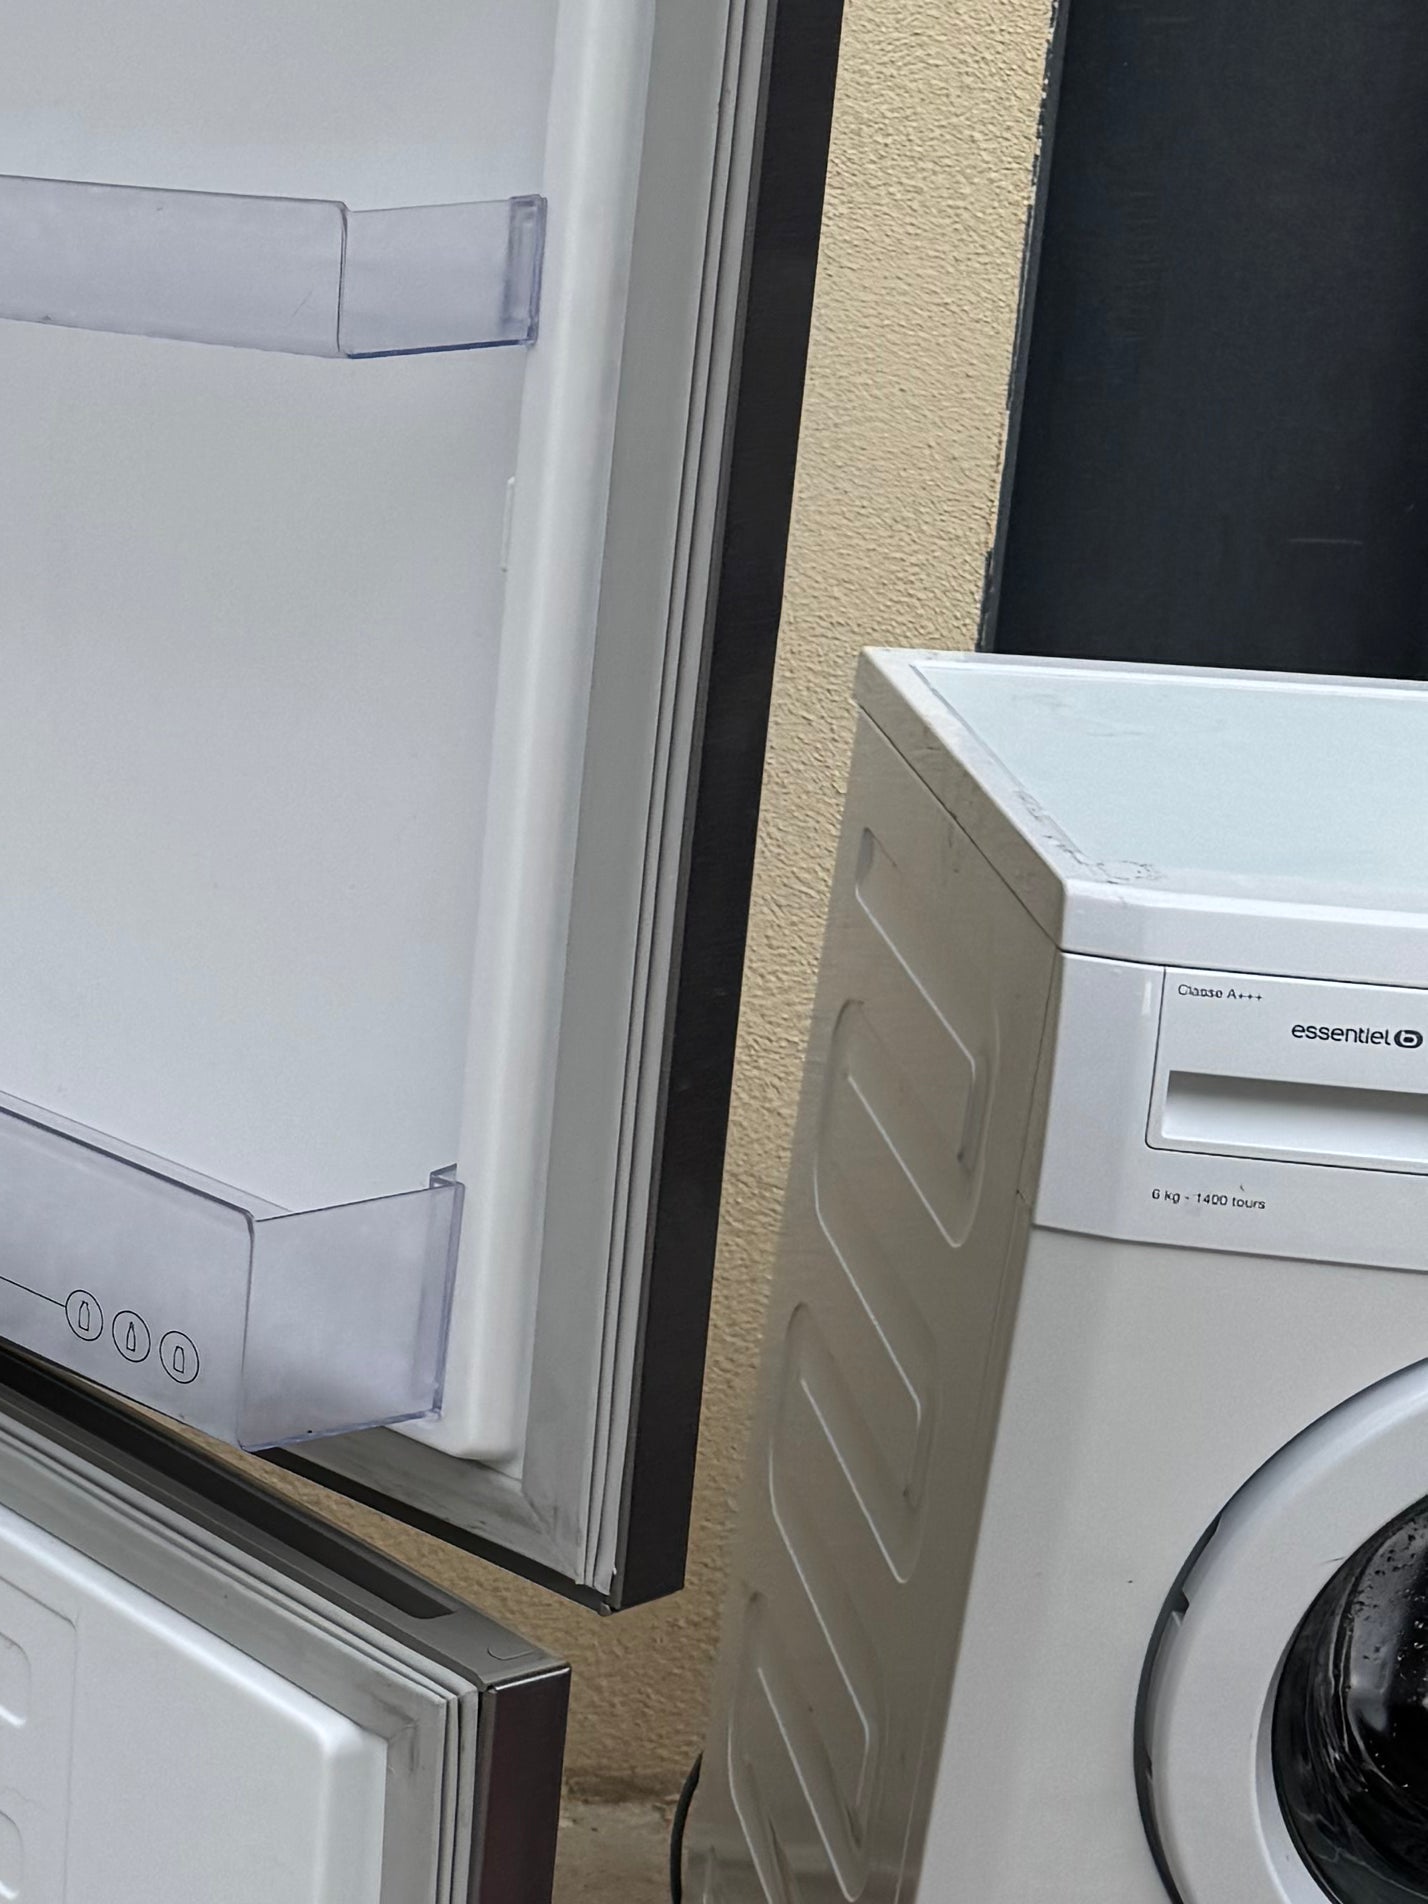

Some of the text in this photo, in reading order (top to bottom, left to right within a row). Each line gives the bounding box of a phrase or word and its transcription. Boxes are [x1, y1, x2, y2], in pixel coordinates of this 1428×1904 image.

[1177, 984, 1263, 1001] Classe A+++
[1291, 1024, 1391, 1046] essentiel
[1152, 1188, 1160, 1200] 6
[1164, 1190, 1181, 1204] kg
[1196, 1193, 1228, 1206] 1400
[1232, 1196, 1266, 1210] tours
